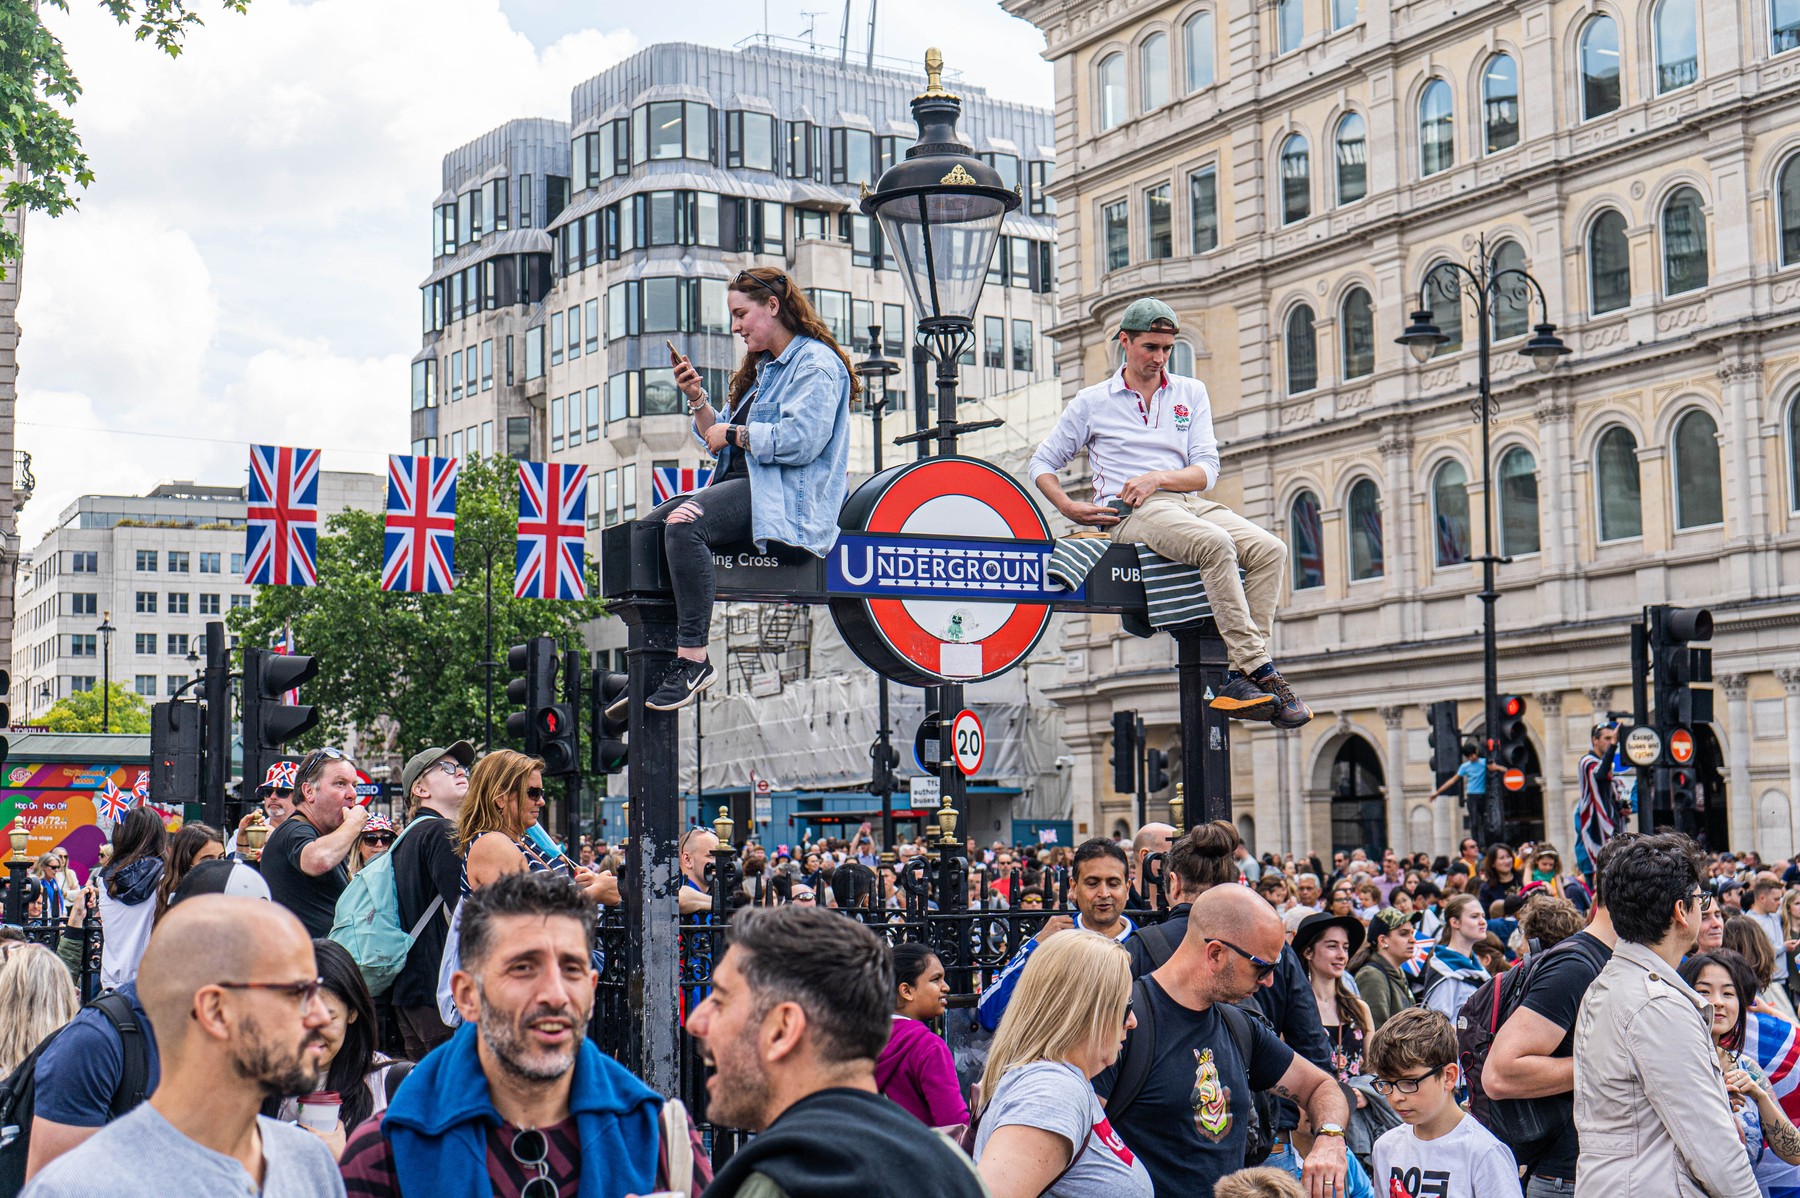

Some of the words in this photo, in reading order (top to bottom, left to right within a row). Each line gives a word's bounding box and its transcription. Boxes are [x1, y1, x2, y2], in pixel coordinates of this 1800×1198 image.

[738, 553, 779, 567] Cross
[1111, 567, 1143, 582] PUB
[958, 730, 980, 756] 20
[913, 788, 938, 796] author
[15, 802, 28, 811] Hop
[29, 802, 38, 810] On
[43, 802, 56, 811] Hop
[57, 802, 67, 811] Off
[22, 815, 60, 825] 4/48/72
